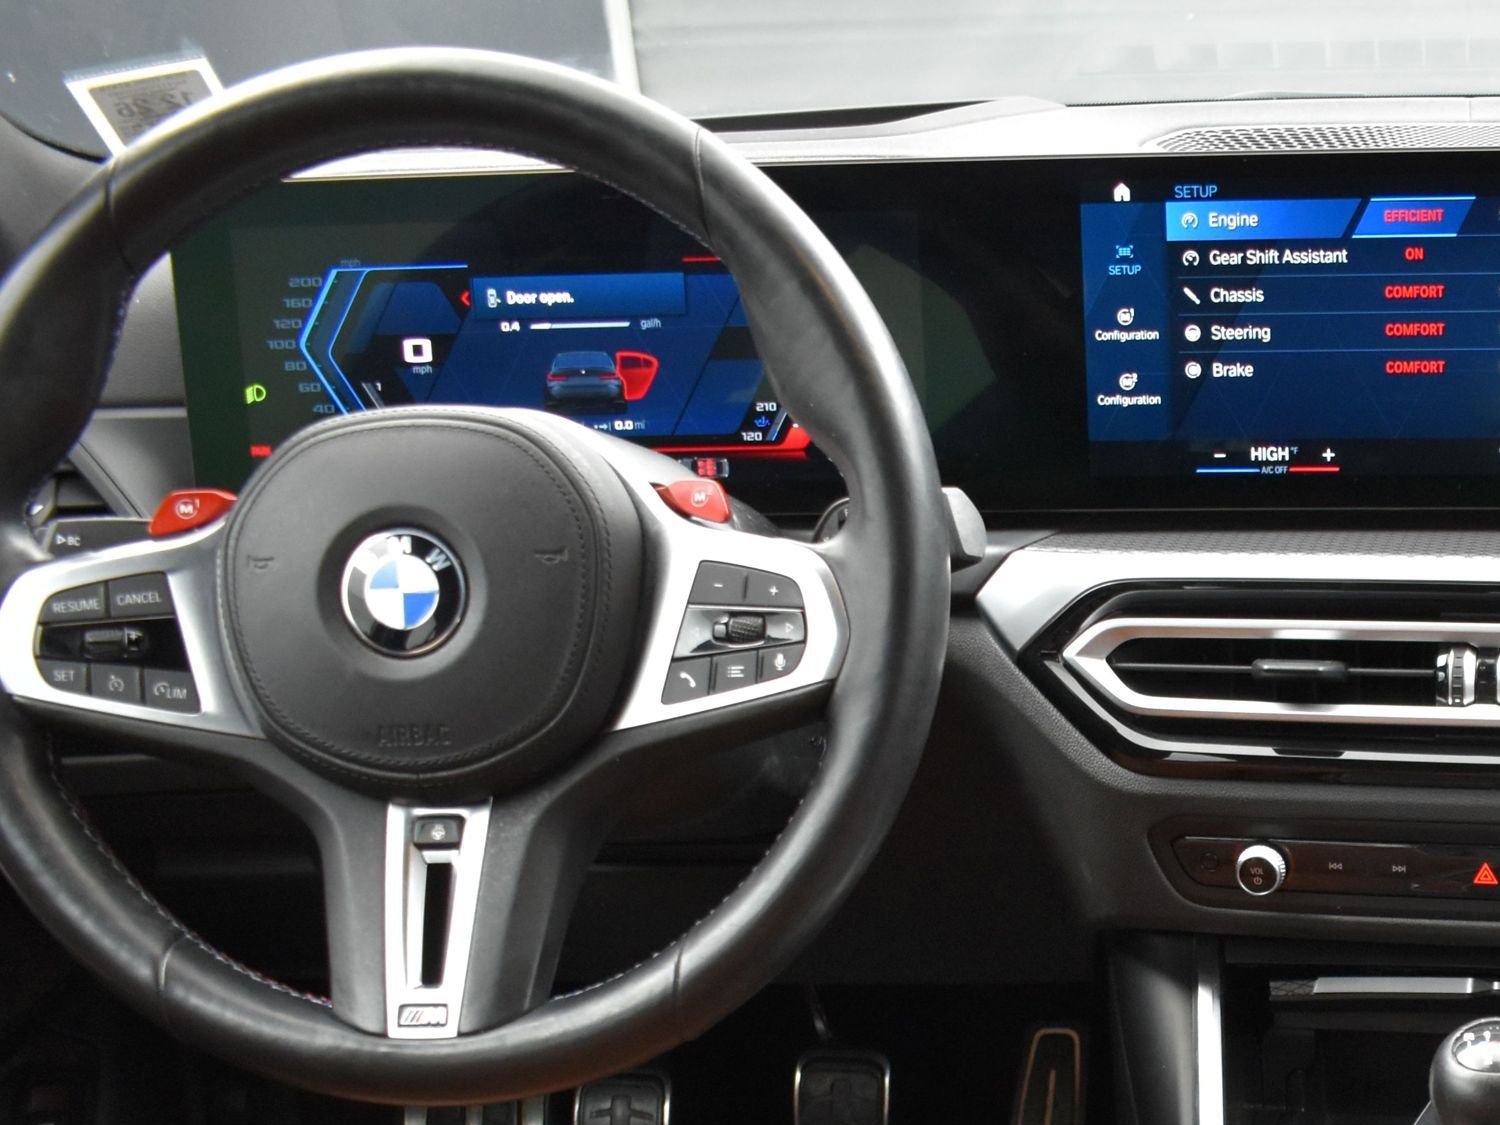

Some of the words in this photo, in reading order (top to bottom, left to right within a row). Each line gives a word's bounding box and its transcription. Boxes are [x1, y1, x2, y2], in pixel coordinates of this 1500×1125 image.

[1174, 185, 1218, 199] SETUP
[1208, 212, 1259, 230] Engine
[1383, 209, 1444, 222] EFFICIENT
[1209, 250, 1244, 265] Gear
[1246, 249, 1280, 265] Shift
[1282, 248, 1349, 264] Assistant
[1405, 247, 1424, 260] ON
[1108, 264, 1142, 275] SETUP
[288, 276, 322, 288] 200
[1210, 287, 1265, 303] Chassis
[1384, 285, 1445, 299] COMFORT
[506, 291, 537, 305] Door
[539, 292, 575, 307] open.
[273, 319, 303, 329] 120
[1385, 323, 1446, 337] COMFORT
[1095, 329, 1160, 342] Configuration
[1210, 325, 1272, 343] Steering
[266, 340, 297, 350] 100
[412, 365, 433, 376] mph
[1212, 362, 1255, 378] Brake
[1385, 360, 1446, 375] COMFORT
[755, 402, 778, 412] 210
[1097, 394, 1162, 407] Configuration
[741, 432, 763, 442] 120
[1250, 446, 1290, 461] HIGH
[1261, 466, 1274, 475] A/C
[1275, 465, 1288, 474] OFF
[116, 591, 162, 606] CANCEL
[52, 598, 100, 614] RESUME
[53, 670, 75, 682] SET
[166, 687, 187, 700] LIM
[1249, 867, 1264, 875] VOL
